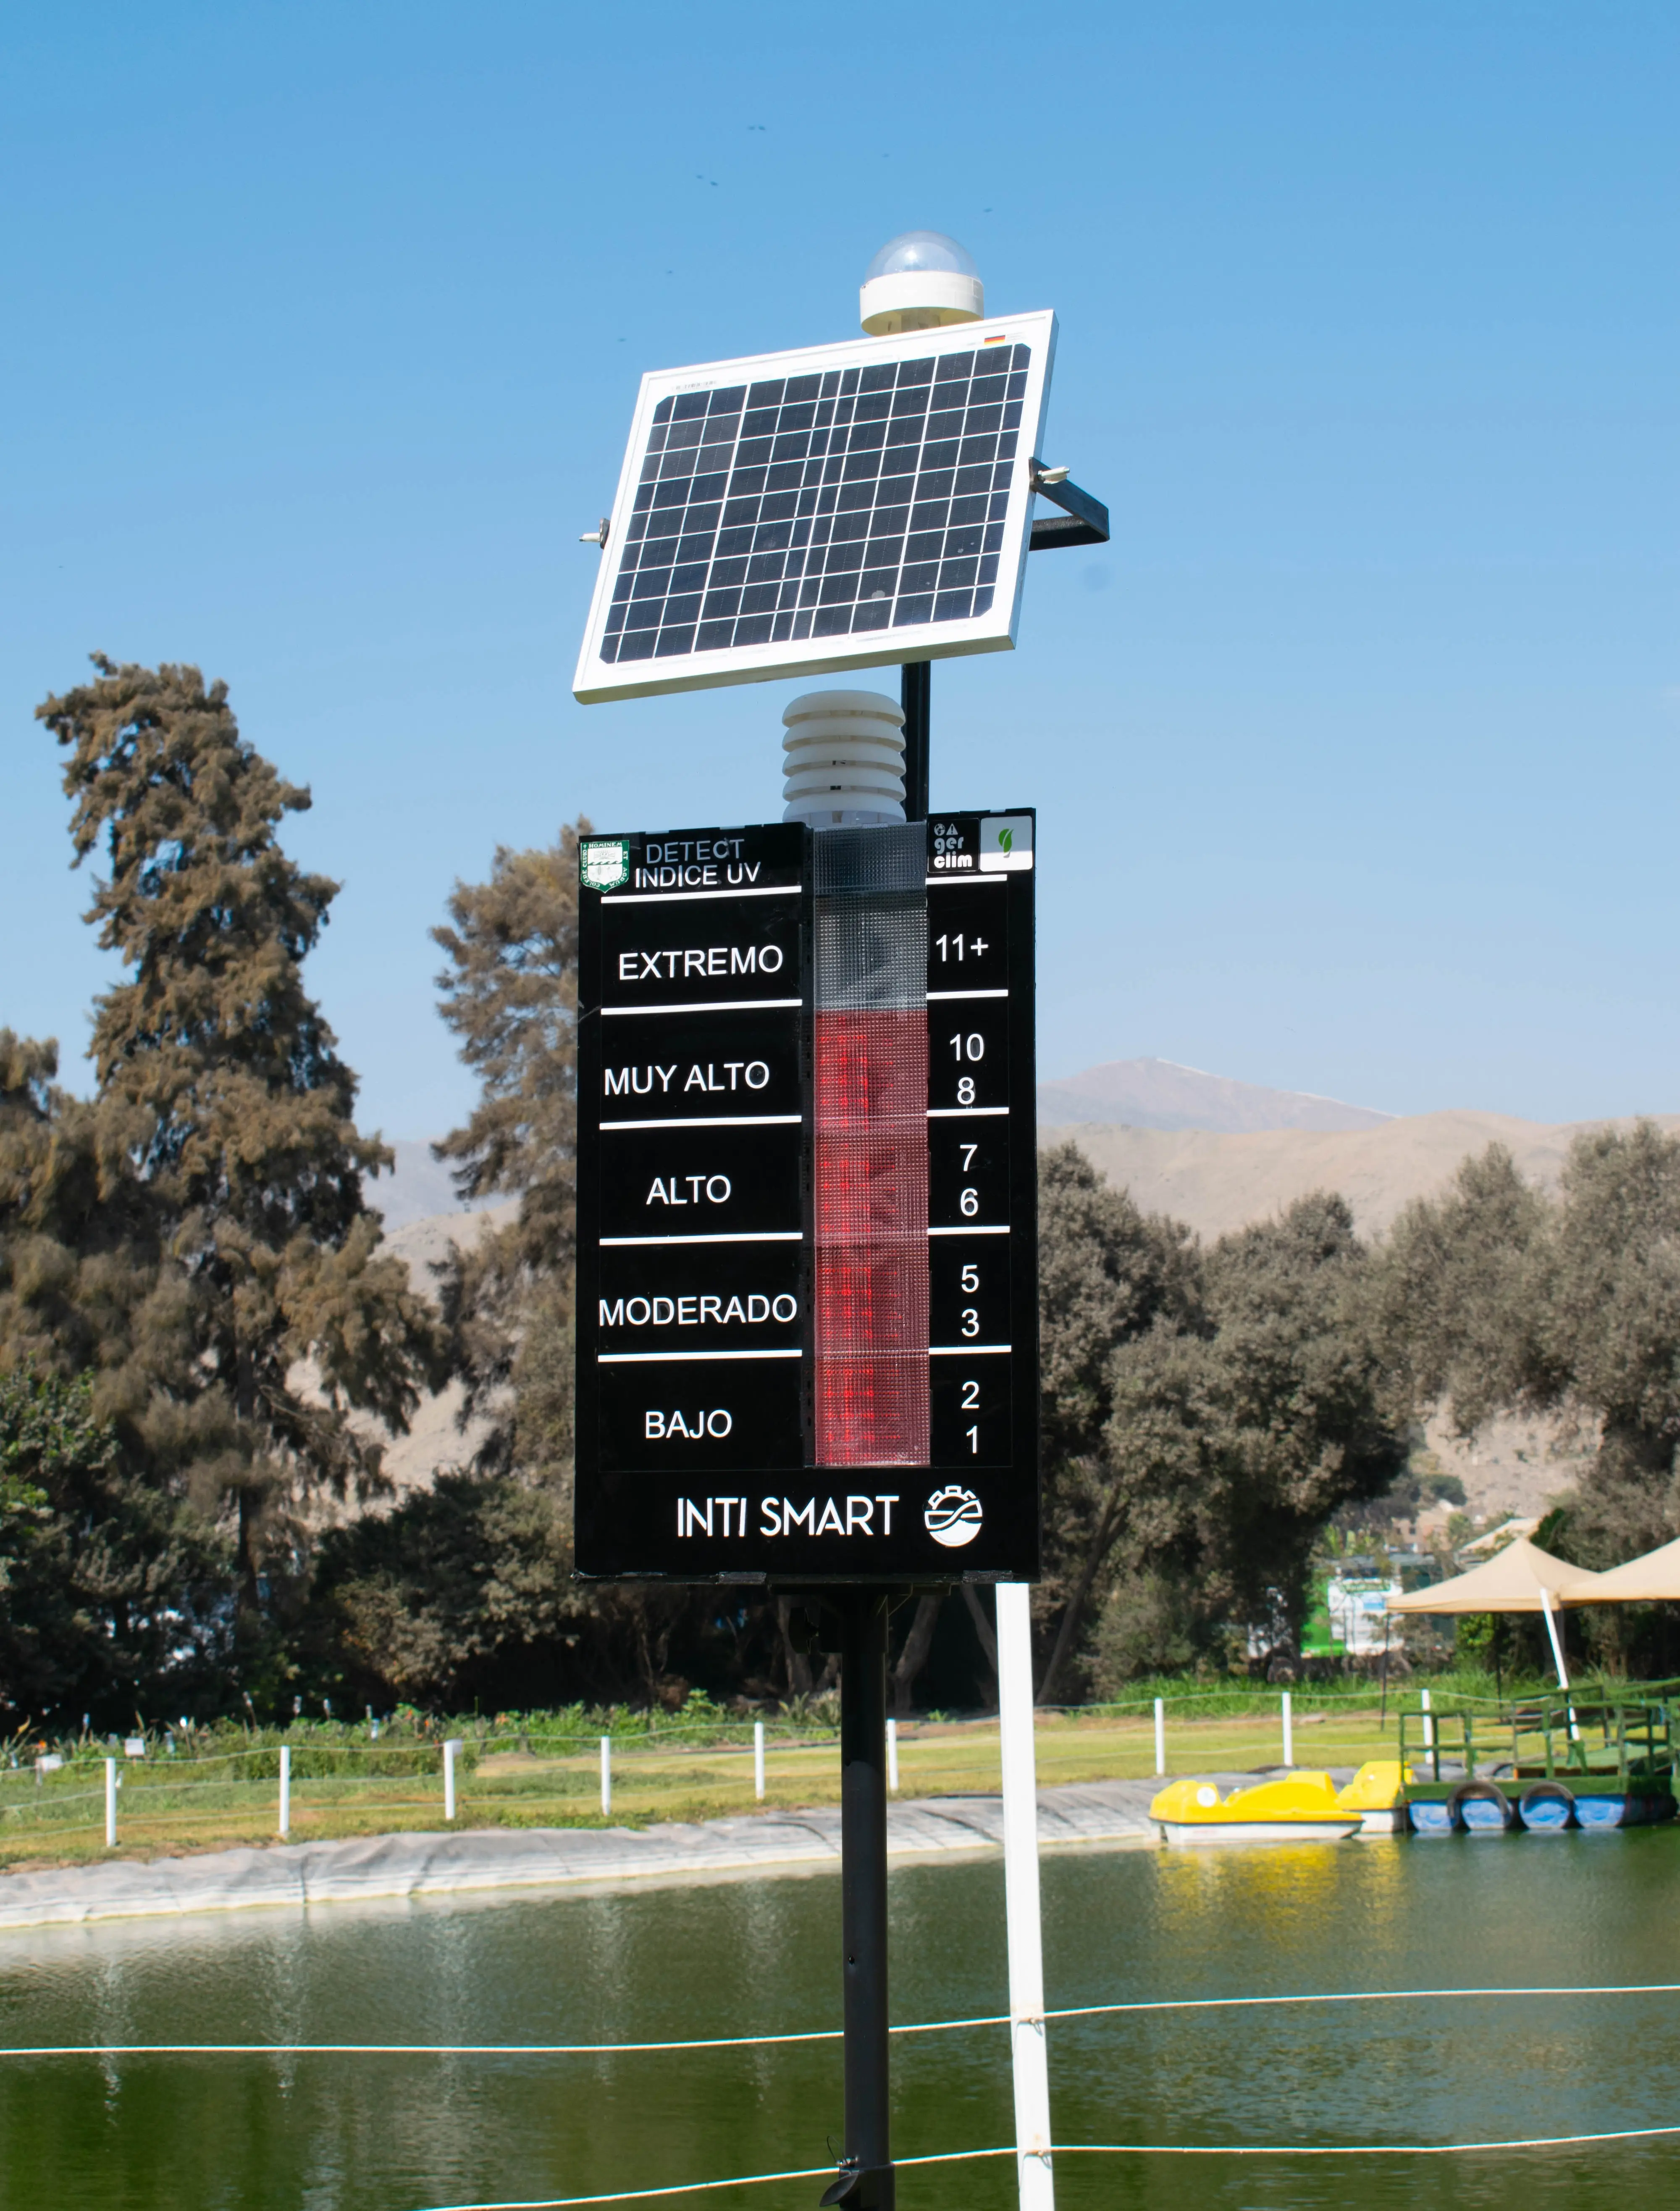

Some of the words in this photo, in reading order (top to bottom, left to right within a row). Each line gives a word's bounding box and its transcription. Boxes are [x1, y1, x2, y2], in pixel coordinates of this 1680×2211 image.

[623, 851, 628, 860] ET
[646, 839, 745, 864] DETECT
[934, 837, 964, 855] ger
[934, 851, 973, 869] clim
[582, 870, 601, 888] COLERE
[609, 867, 627, 887] AGRUM
[635, 864, 718, 888] INDICE
[727, 862, 761, 884] UV
[936, 933, 988, 962] 11+
[619, 945, 783, 980] EXTREMO
[950, 1033, 984, 1061] 10
[605, 1065, 677, 1096] MUY
[684, 1061, 769, 1091] ALTO
[957, 1077, 975, 1105] 8
[960, 1144, 978, 1172] 7
[646, 1175, 731, 1205] ALTO
[960, 1188, 978, 1216] 6
[961, 1265, 979, 1293] 5
[599, 1294, 797, 1326] MODERADO
[961, 1309, 979, 1337] 3
[961, 1381, 979, 1409] 2
[646, 1409, 732, 1439] BAJO
[966, 1425, 977, 1454] 1
[677, 1497, 747, 1537] INTI
[760, 1495, 900, 1536] SMART
